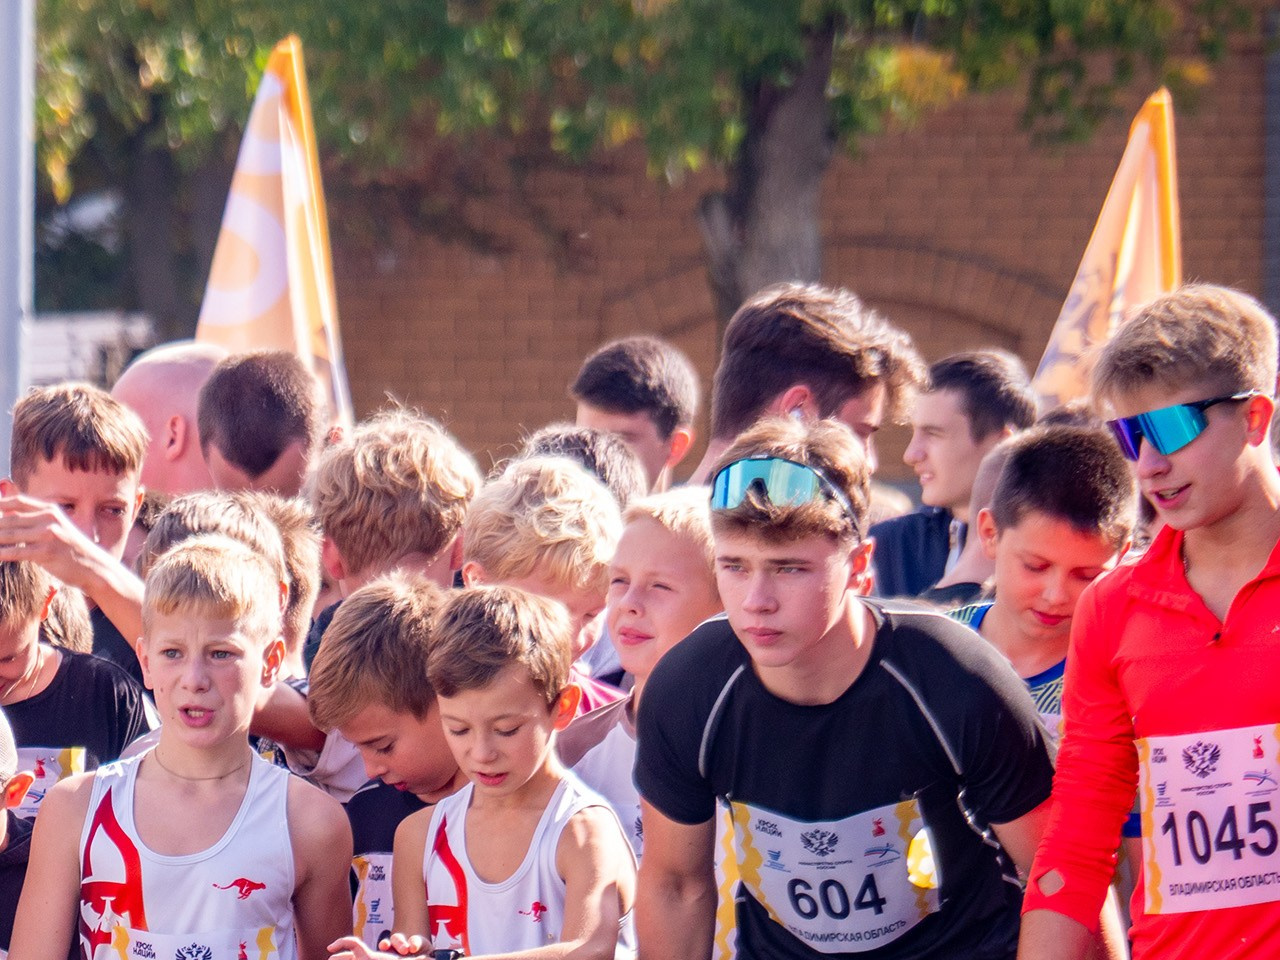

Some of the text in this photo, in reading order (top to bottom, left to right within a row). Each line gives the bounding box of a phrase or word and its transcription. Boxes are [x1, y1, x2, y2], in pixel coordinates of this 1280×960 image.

[1161, 801, 1279, 867] 1045
[787, 873, 887, 920] 604
[1169, 878, 1237, 896] ВЛАДИМИРСКАЯ
[863, 920, 908, 940] ОБЛАСТЬ
[133, 947, 156, 959] НАЦИИ
[135, 941, 153, 951] КРОСС
